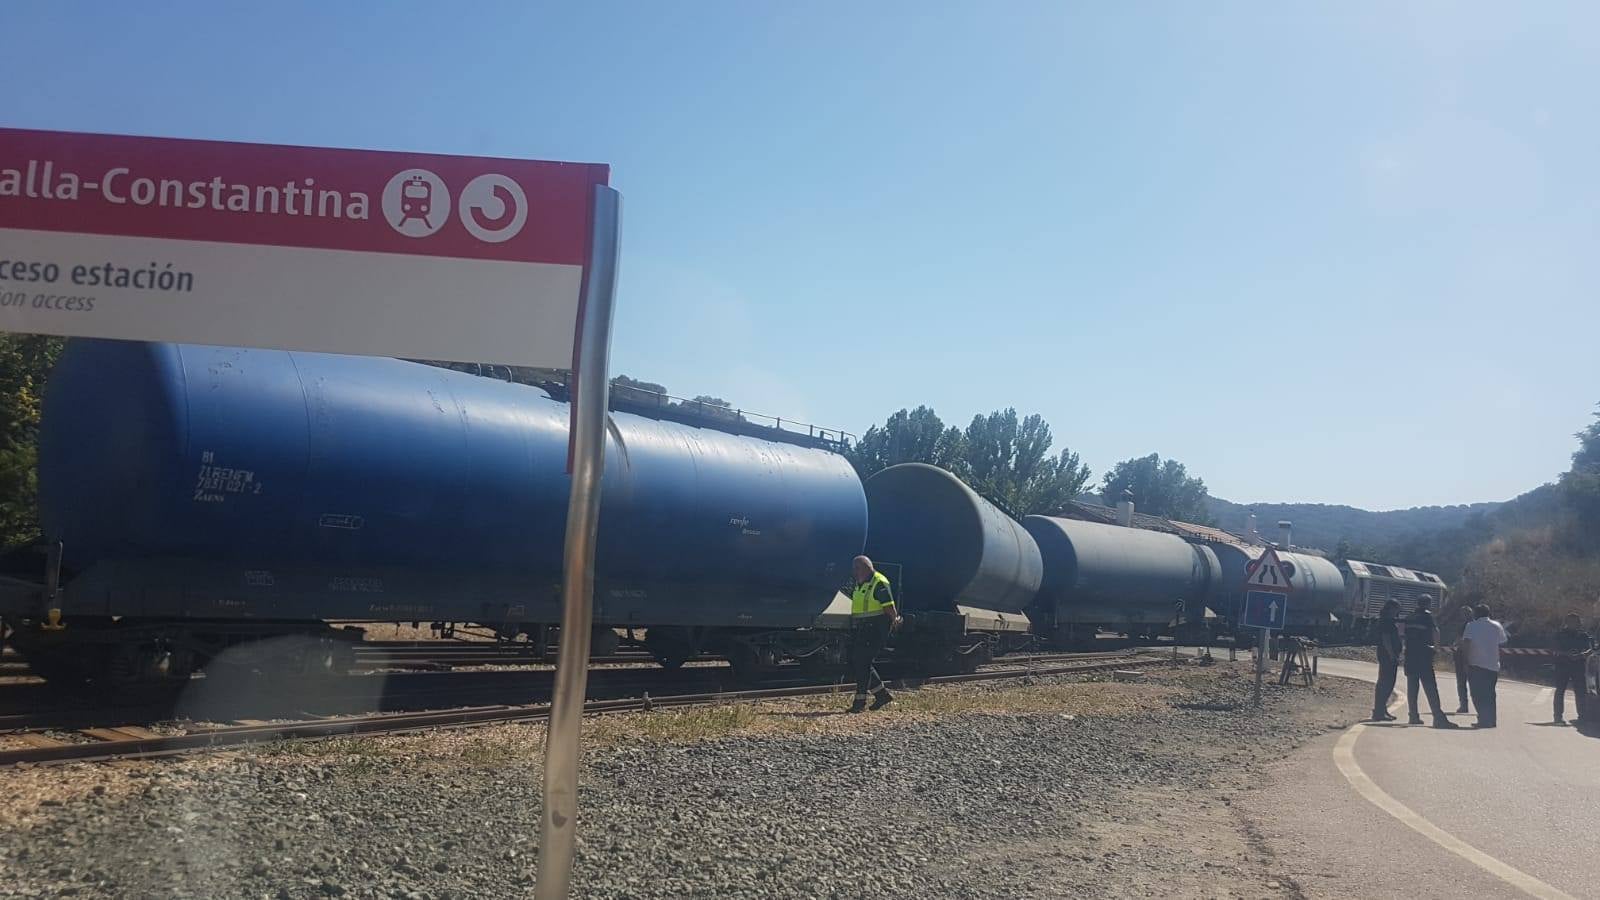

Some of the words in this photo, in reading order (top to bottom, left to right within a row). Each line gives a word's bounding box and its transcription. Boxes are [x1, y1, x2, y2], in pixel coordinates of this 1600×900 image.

[71, 262, 194, 293] estación
[0, 291, 26, 307] on
[32, 292, 96, 312] access
